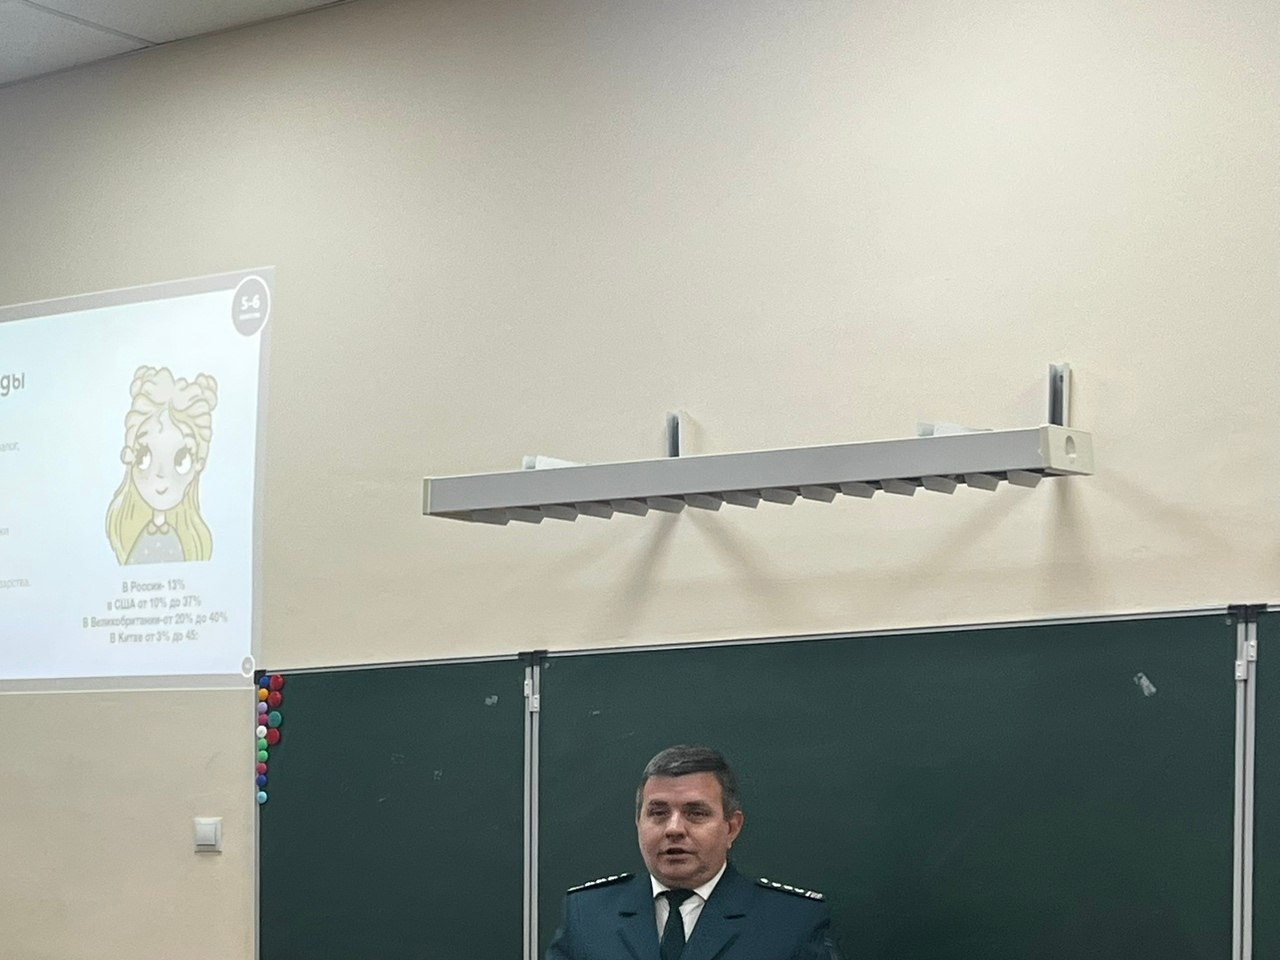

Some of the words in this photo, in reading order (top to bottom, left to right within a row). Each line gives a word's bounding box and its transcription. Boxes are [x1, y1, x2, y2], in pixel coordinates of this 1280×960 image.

[241, 294, 260, 310] 5-6
[122, 581, 128, 593] В
[167, 578, 185, 590] 13%
[114, 598, 136, 610] США
[137, 600, 147, 609] от
[150, 597, 167, 608] 10%
[169, 598, 180, 610] до
[182, 595, 202, 607] 37%
[82, 617, 88, 628] В
[175, 612, 193, 624] 20%
[195, 614, 207, 625] до
[209, 611, 228, 623] 40%
[110, 632, 116, 643] В
[118, 632, 143, 643] Китае
[145, 633, 155, 642] от
[156, 630, 170, 642] 3%
[172, 631, 183, 643] до
